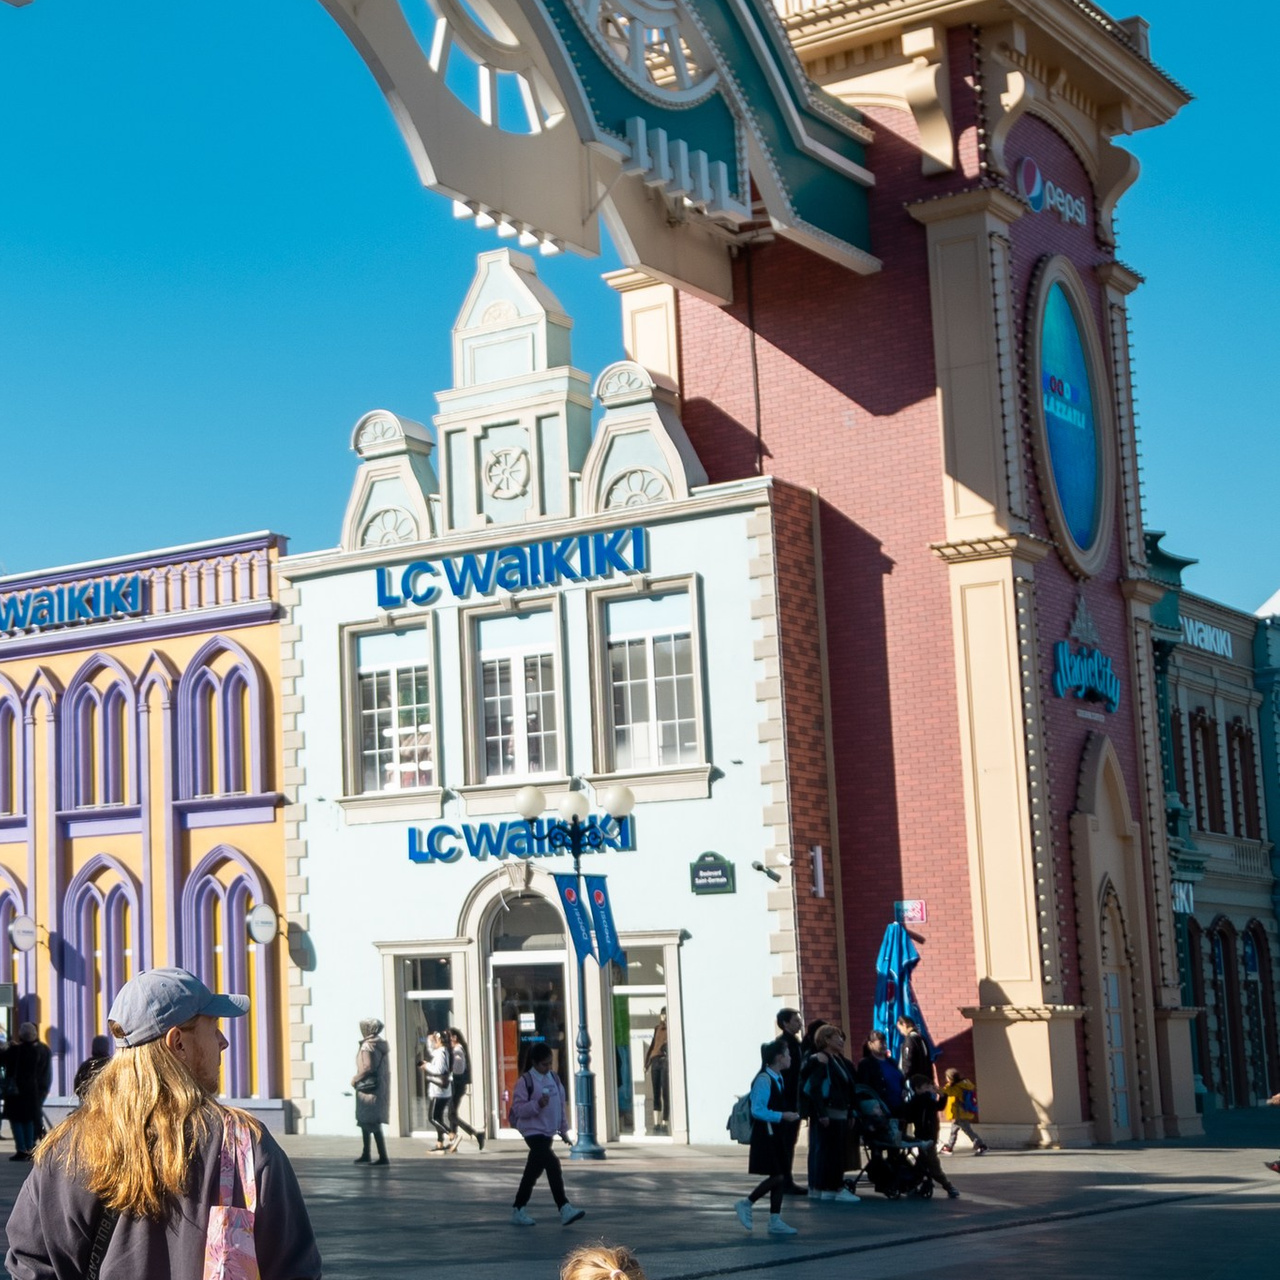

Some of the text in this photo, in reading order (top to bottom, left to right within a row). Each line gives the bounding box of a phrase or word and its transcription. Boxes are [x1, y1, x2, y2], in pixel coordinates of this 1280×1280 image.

[1045, 180, 1087, 226] pepsi
[375, 560, 441, 608] LC
[407, 824, 462, 863] LC
